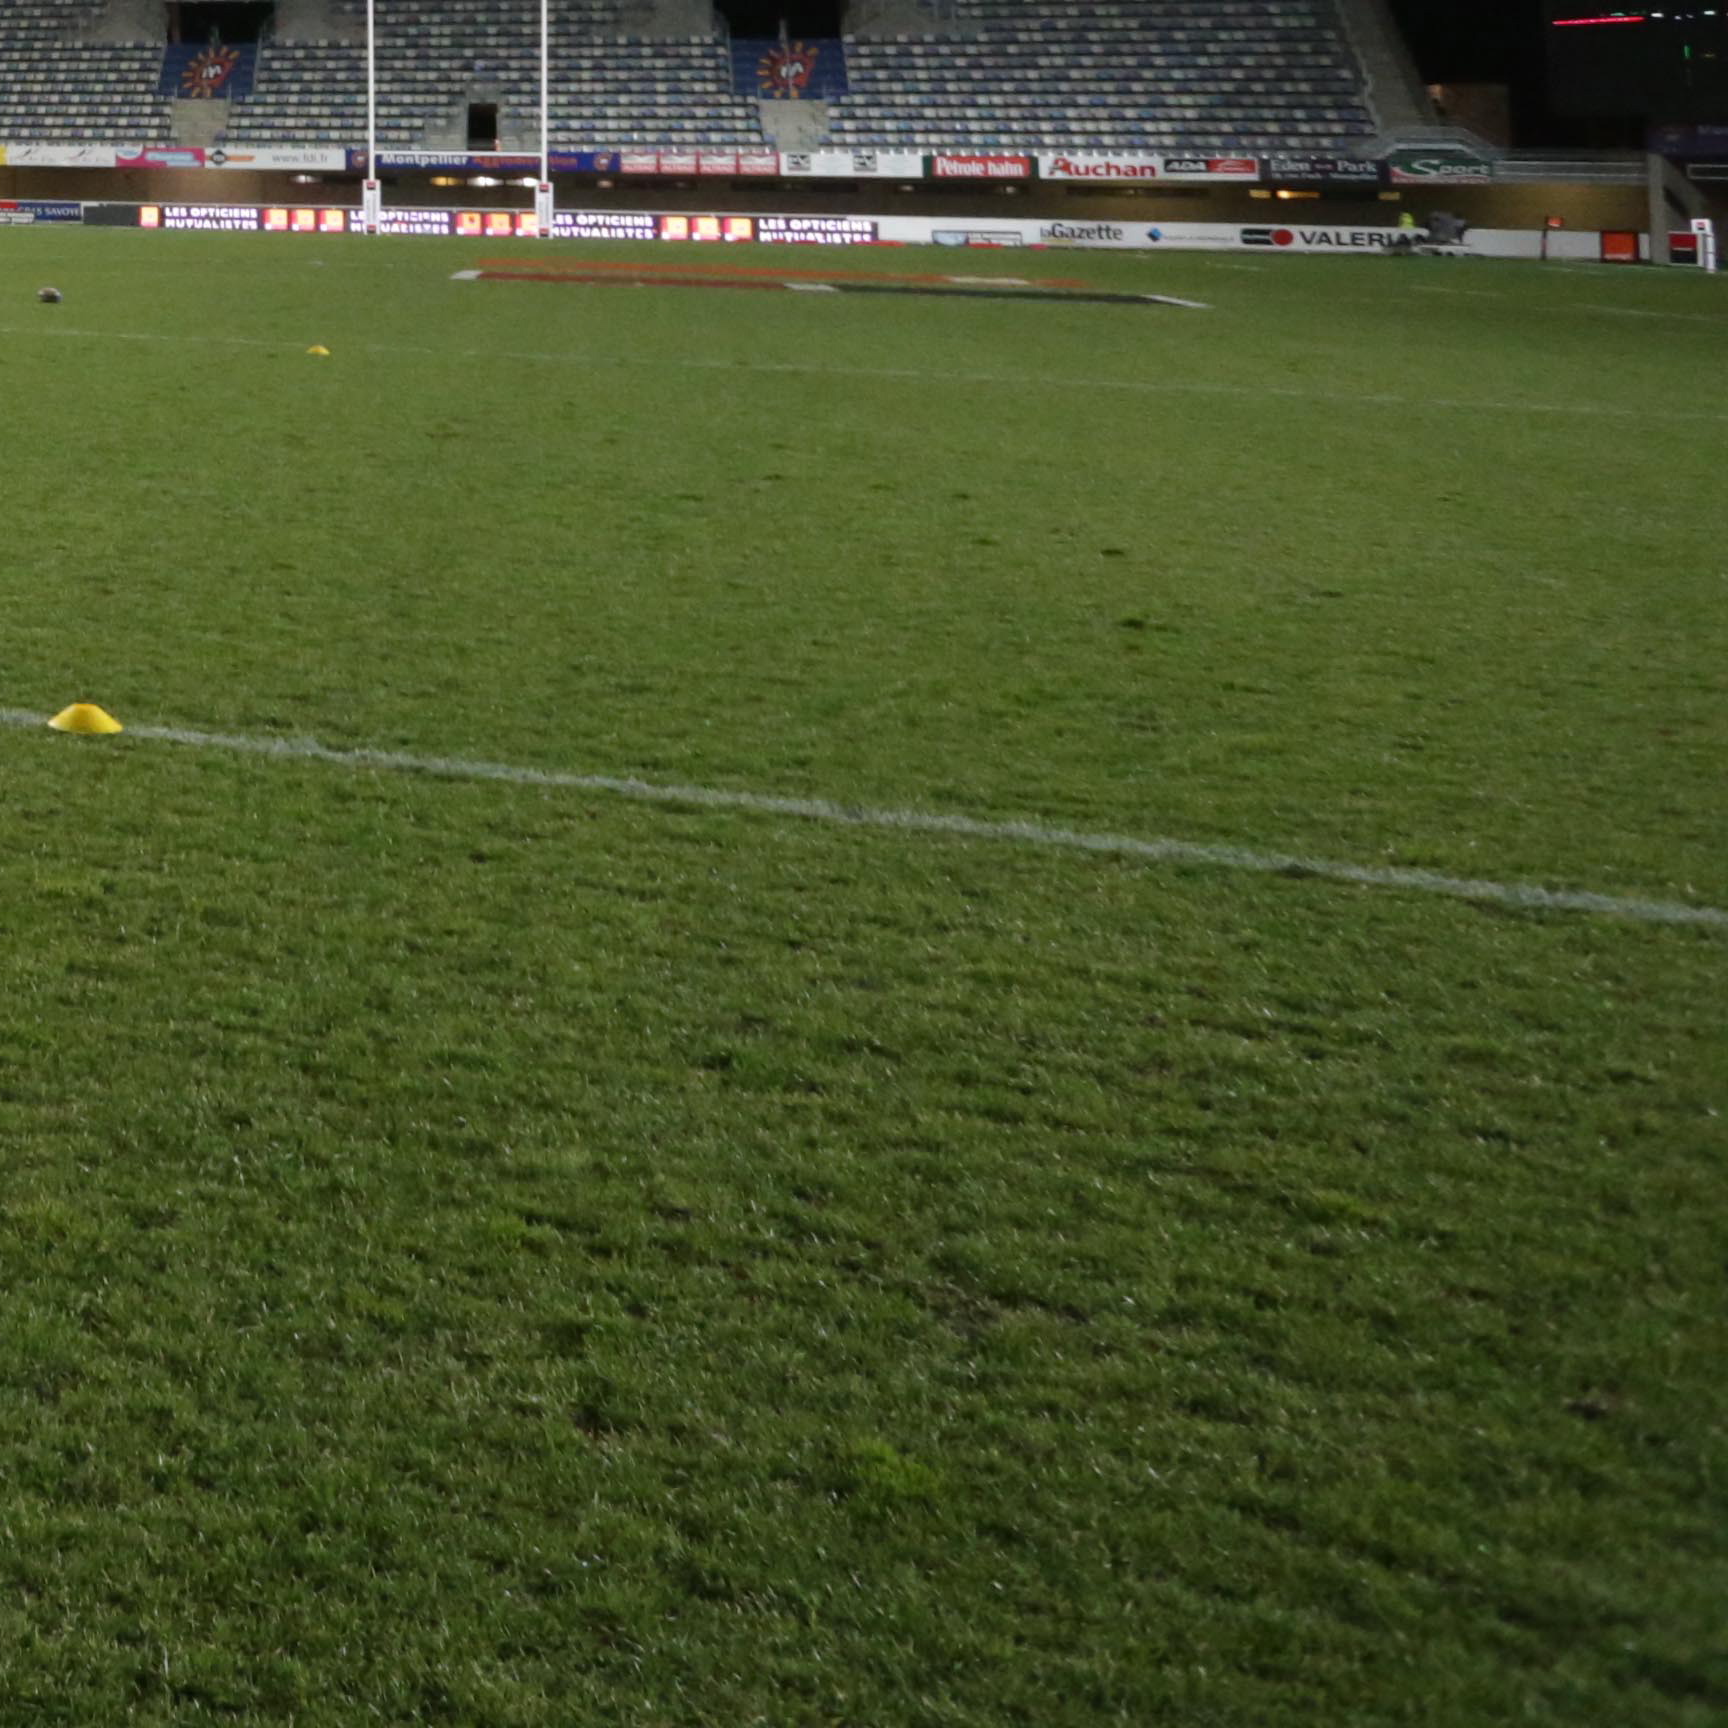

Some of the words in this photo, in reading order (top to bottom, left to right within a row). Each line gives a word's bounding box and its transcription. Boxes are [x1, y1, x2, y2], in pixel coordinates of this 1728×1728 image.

[381, 154, 469, 167] Montpellier
[1270, 159, 1311, 172] Eden
[1337, 159, 1378, 173] Park
[987, 160, 1024, 177] hahn
[1048, 158, 1157, 177] Auchan
[1411, 159, 1490, 176] Sport
[165, 207, 187, 218] LES
[190, 207, 258, 219] OPTICIENS
[350, 210, 365, 221] LE
[165, 218, 258, 230] MUTUALISTES
[576, 214, 654, 227] OPTICIENS
[759, 218, 787, 230] LES
